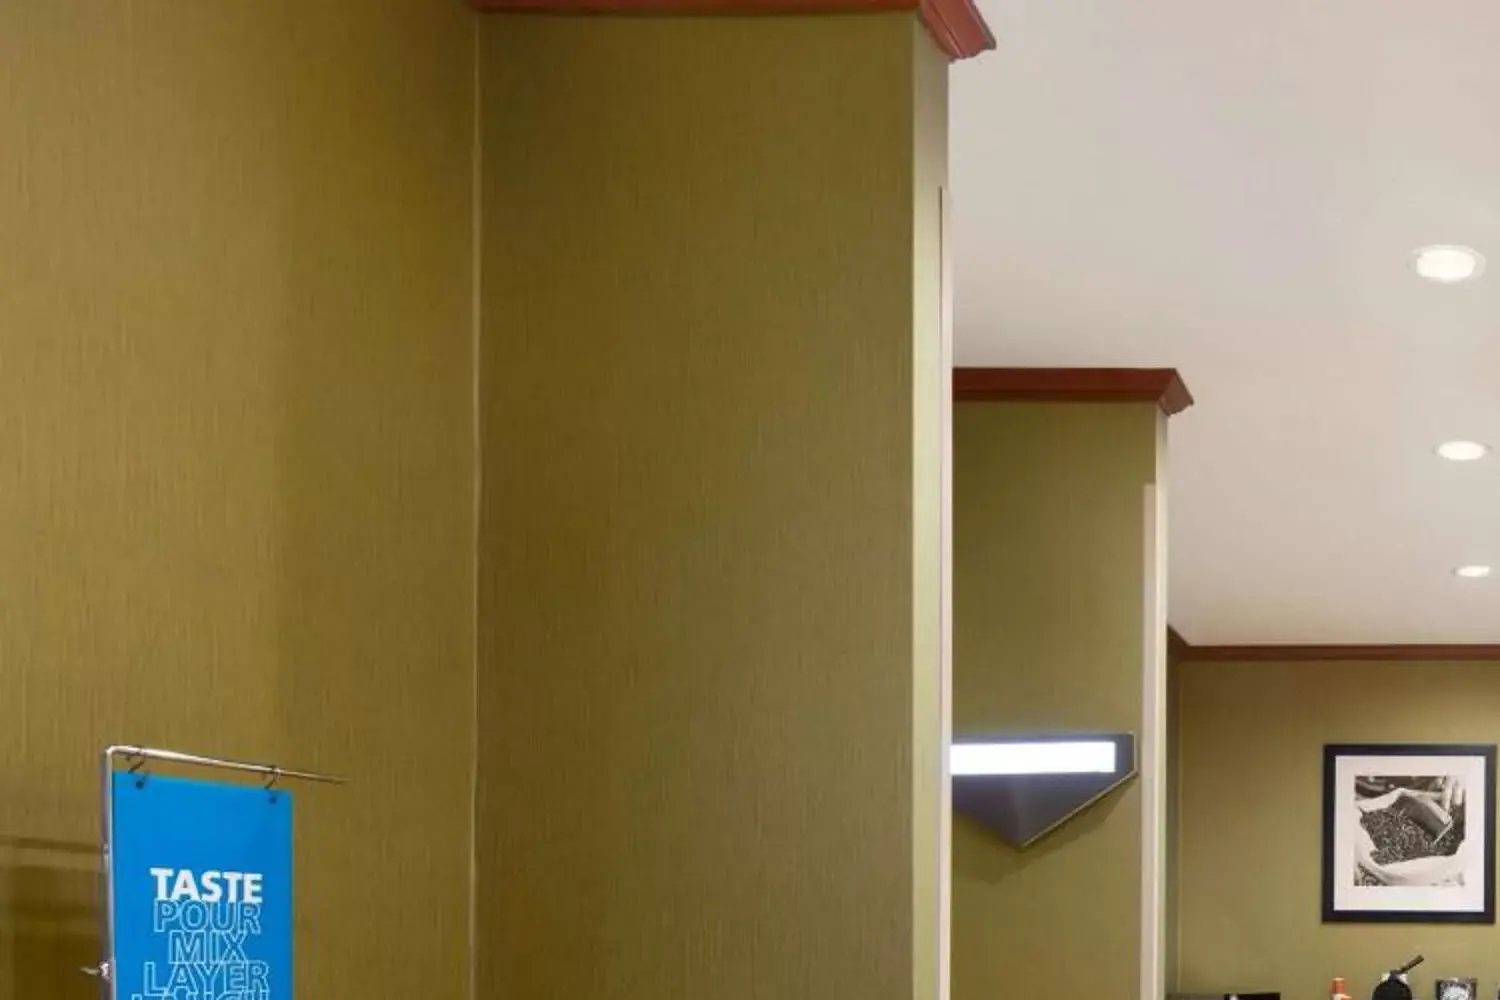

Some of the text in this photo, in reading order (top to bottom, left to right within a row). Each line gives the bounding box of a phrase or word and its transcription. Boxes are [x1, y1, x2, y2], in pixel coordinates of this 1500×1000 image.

[150, 868, 263, 903] TASTE
[154, 898, 261, 934] POUR
[168, 930, 248, 964] MIX
[143, 960, 270, 997] LAYER
